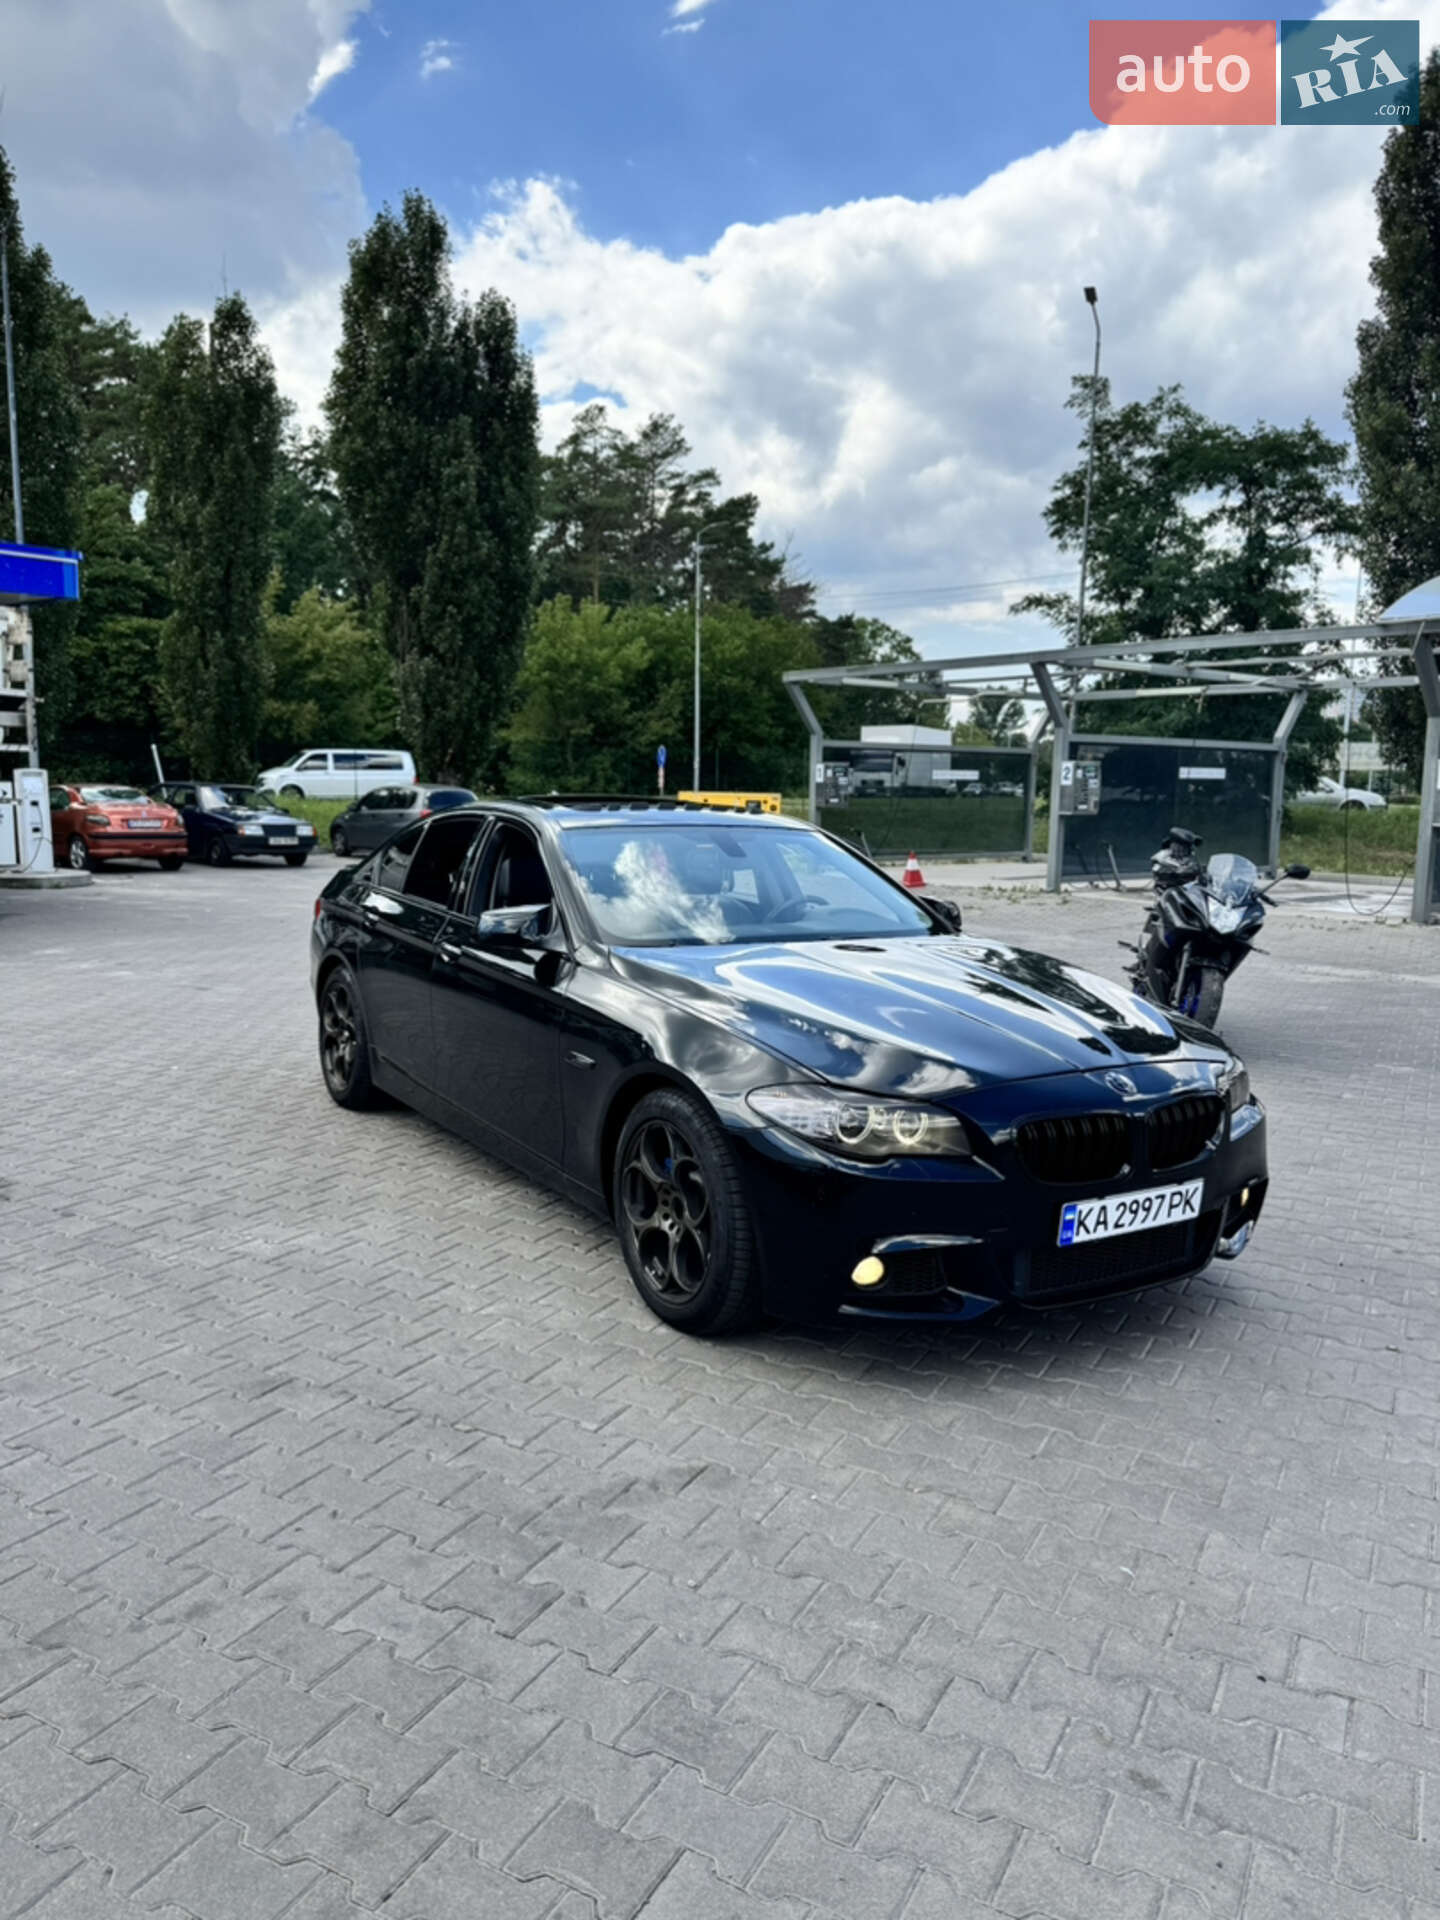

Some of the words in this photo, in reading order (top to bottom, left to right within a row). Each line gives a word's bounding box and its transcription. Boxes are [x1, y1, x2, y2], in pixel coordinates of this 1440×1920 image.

[1063, 765, 1071, 781] 2
[1075, 1204, 1109, 1237] KA
[1113, 1193, 1166, 1230] 2997
[1167, 1185, 1200, 1217] PK
